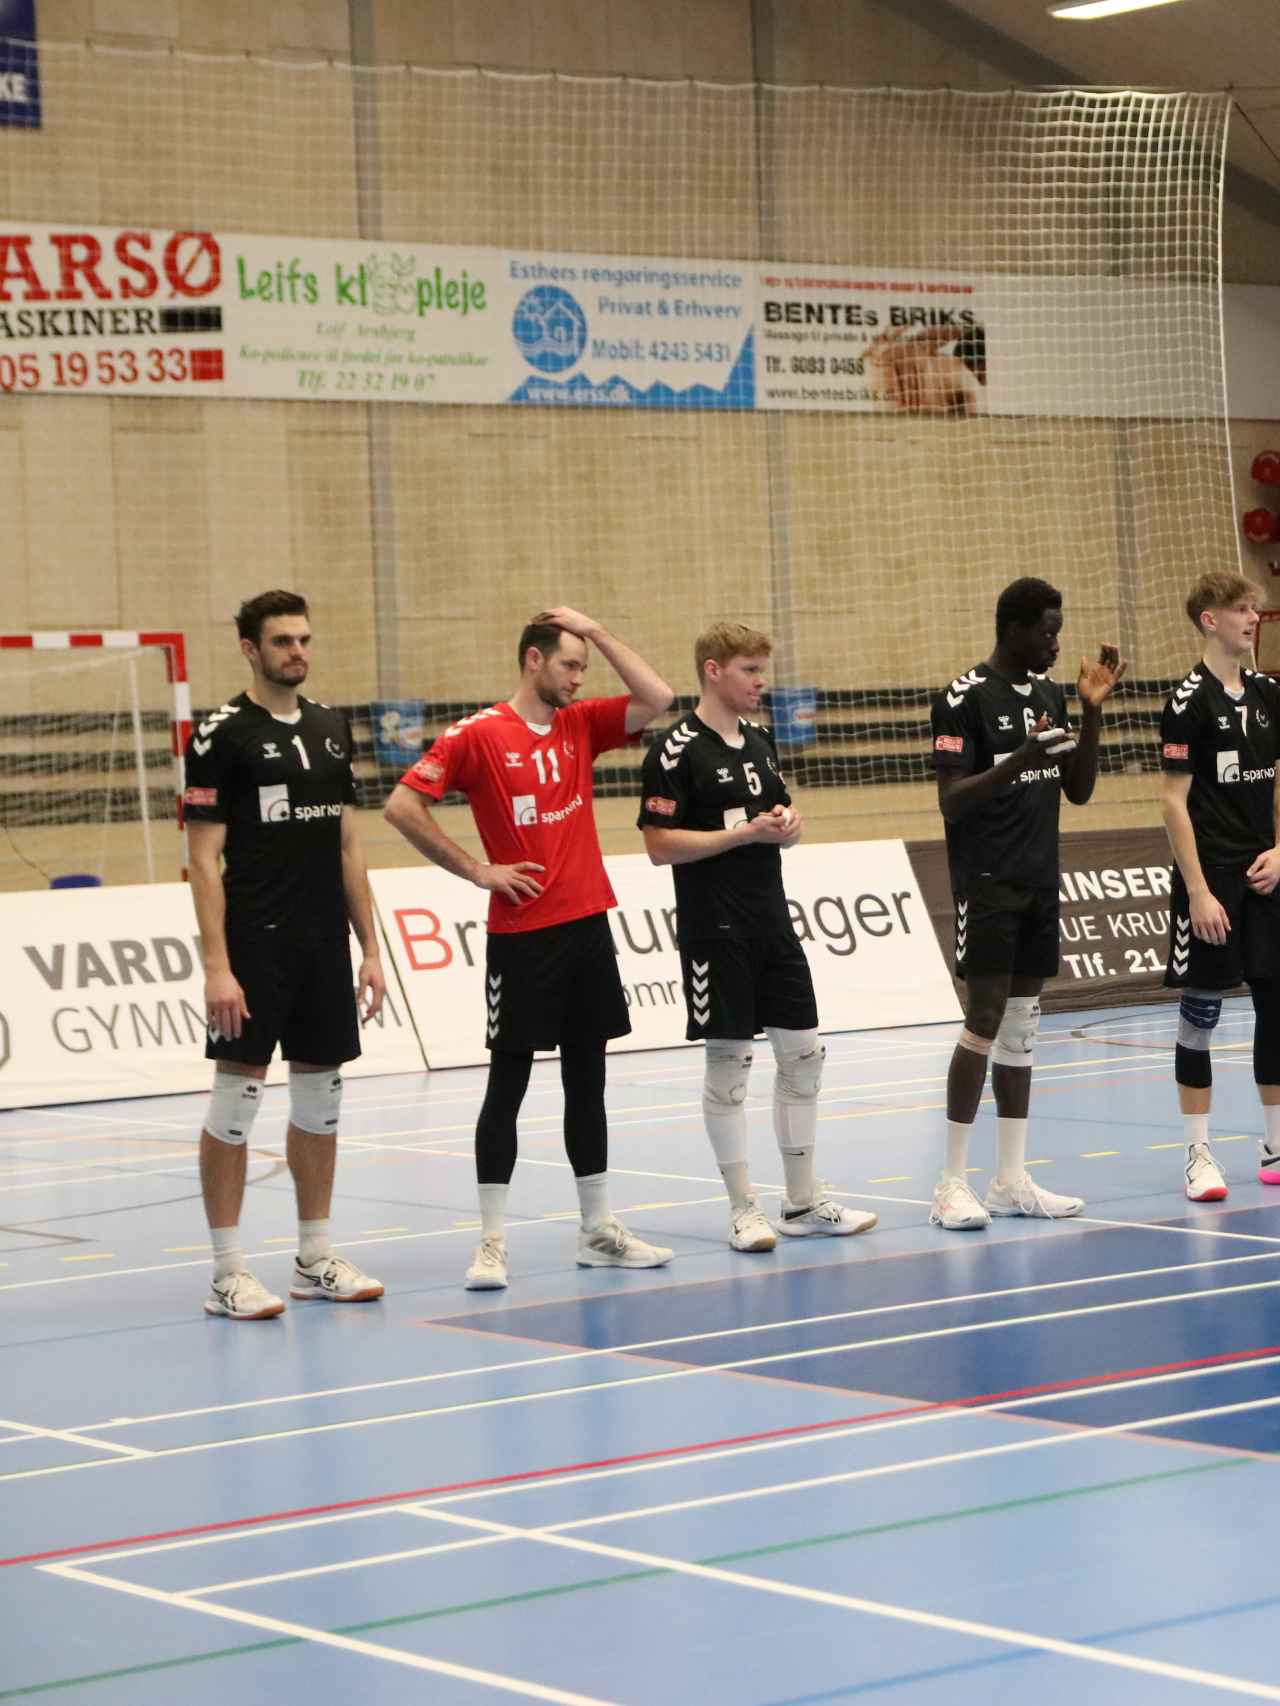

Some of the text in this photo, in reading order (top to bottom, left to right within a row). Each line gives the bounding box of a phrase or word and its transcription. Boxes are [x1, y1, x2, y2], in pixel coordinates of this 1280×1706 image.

[236, 255, 319, 304] Leifs
[509, 260, 577, 280] Esthers
[597, 296, 653, 317] Privat
[656, 298, 669, 316] &
[764, 301, 975, 327] BENTEs BRIKS
[51, 351, 89, 387] 19
[96, 350, 139, 385] 53
[147, 347, 188, 382] 33
[591, 339, 645, 360] Mobil:
[694, 343, 732, 363] 5431
[1234, 704, 1248, 738] 7
[291, 734, 312, 770] 1
[531, 747, 561, 785] 11
[742, 761, 763, 797] 5
[1058, 864, 1173, 903] INSER
[785, 890, 912, 957] ager
[1059, 914, 1103, 943] UE
[1106, 909, 1171, 939] KRU
[22, 934, 206, 991] VARD
[1062, 951, 1117, 980] Tlf.
